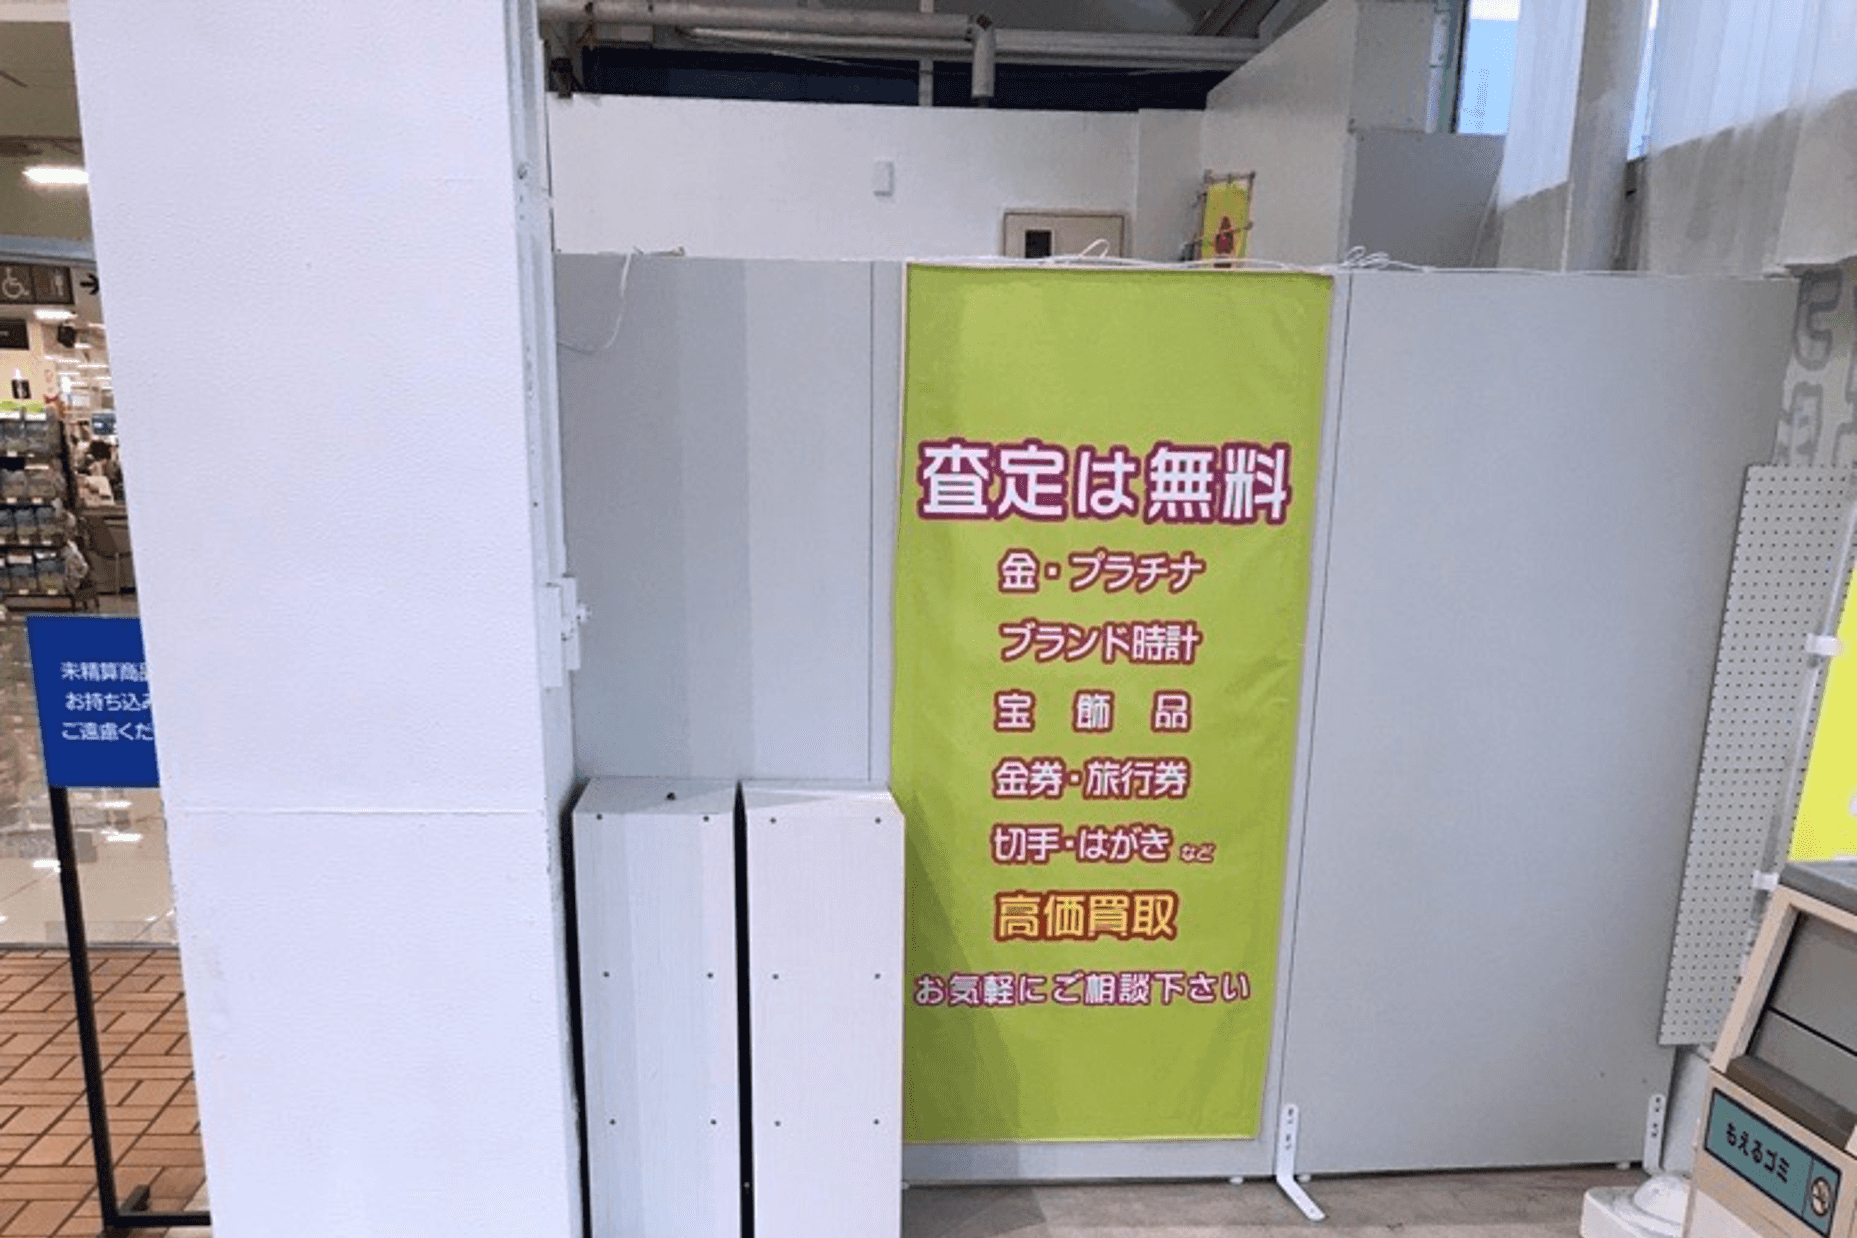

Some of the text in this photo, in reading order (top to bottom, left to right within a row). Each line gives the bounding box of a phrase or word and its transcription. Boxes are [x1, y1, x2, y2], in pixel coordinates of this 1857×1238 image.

[917, 437, 1292, 524] 査定は無料
[998, 547, 1206, 594] 金・プラチナ
[998, 617, 1203, 664] ブランド時計
[992, 756, 1190, 799] 金券・旅行券
[991, 823, 1217, 864] 切手・はがき など
[994, 889, 1179, 942] 高価買取
[912, 969, 1252, 1007] お気軽にご相談下さい
[1725, 1122, 1791, 1184] もえるゴミ
